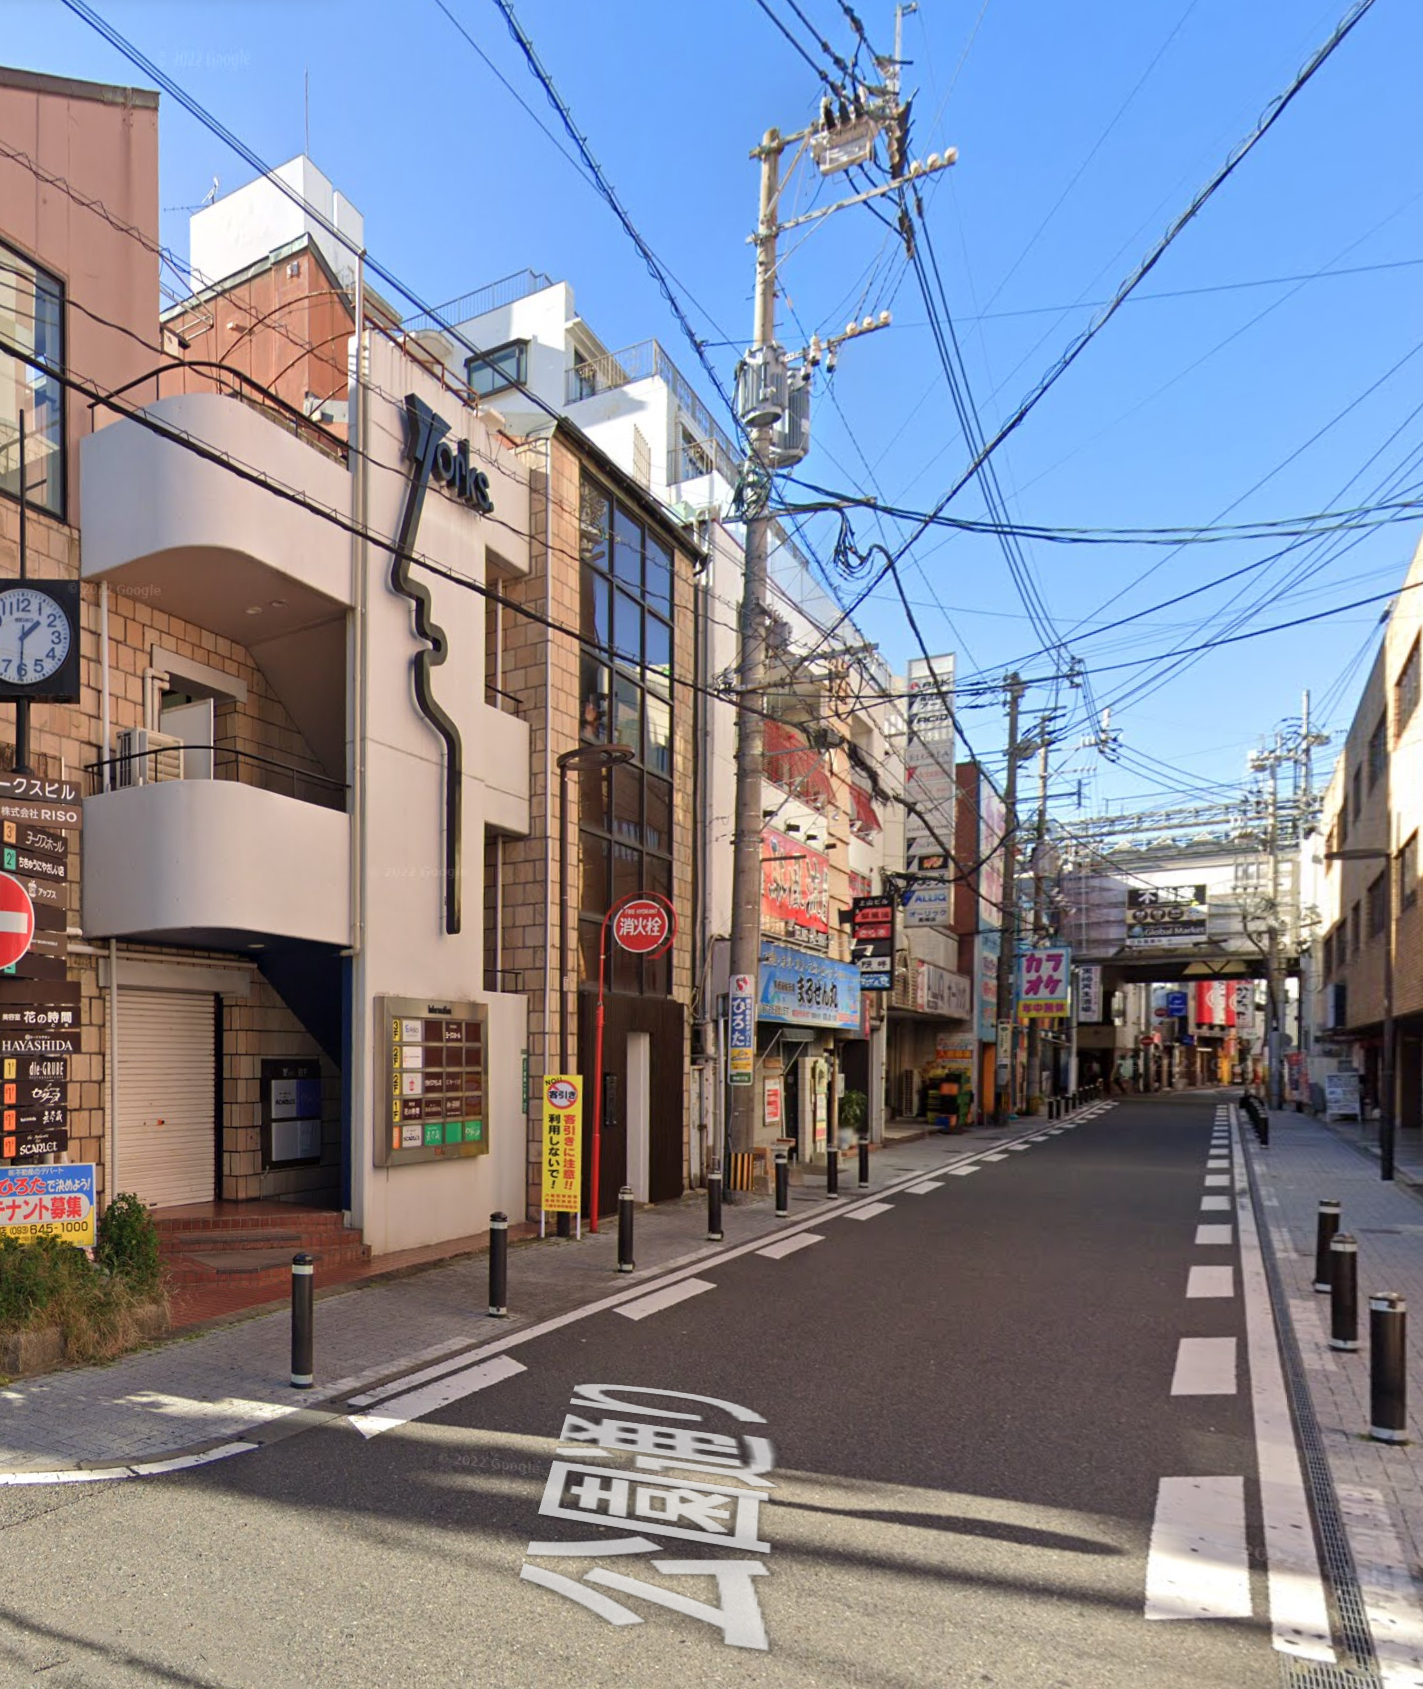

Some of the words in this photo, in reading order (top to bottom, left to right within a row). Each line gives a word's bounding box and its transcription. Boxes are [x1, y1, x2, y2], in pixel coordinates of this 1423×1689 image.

[16, 598, 31, 613] 12
[47, 614, 57, 628] 2
[51, 631, 61, 645] 3
[46, 647, 57, 661] 4
[2, 659, 12, 672] 7
[17, 663, 28, 677] 6
[33, 659, 44, 673] 5
[1, 806, 38, 819] 株式会社
[41, 809, 77, 823] RISO
[25, 831, 65, 853] ヨークスホール
[619, 916, 662, 936] 消火栓
[23, 1010, 73, 1024] 花の時間
[731, 998, 746, 1046] ひろた
[2, 1040, 73, 1051] HAYASHIDA
[548, 1089, 577, 1100] 客引き
[19, 1141, 58, 1156] SCARLET
[548, 1113, 561, 1189] 利用しないで!
[520, 1384, 777, 1651] 公園通り
